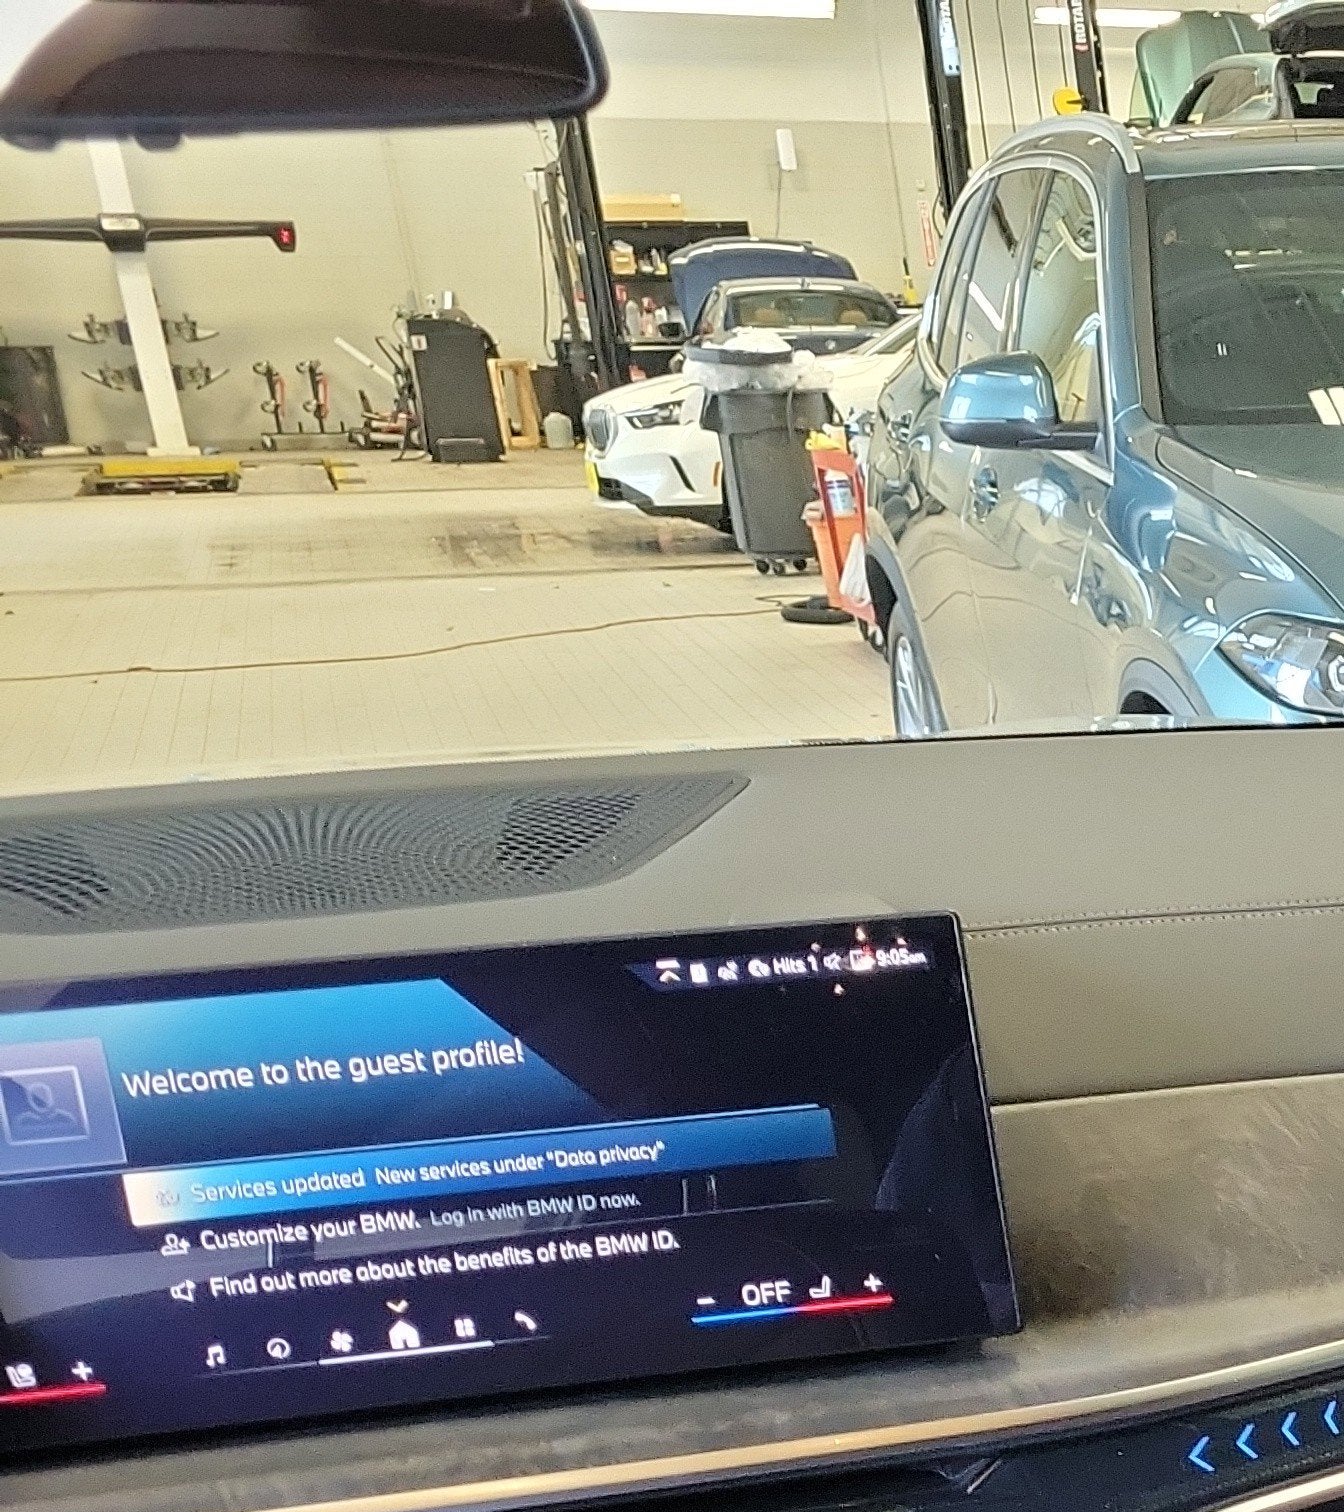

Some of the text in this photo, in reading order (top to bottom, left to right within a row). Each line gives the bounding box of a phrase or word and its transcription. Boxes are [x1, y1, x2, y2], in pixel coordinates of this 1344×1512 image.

[121, 1037, 525, 1099] Welcome to the guest profile!
[190, 1179, 278, 1203] Services
[282, 1167, 366, 1197] updated
[375, 1166, 416, 1185] New
[419, 1159, 492, 1183] services
[493, 1152, 545, 1175] under
[200, 1192, 642, 1251] Customize your BMW. Log in with BMW ID now.
[209, 1229, 683, 1299] Find out more about the benefits of the BMW ID.
[741, 1279, 792, 1306] OFF
